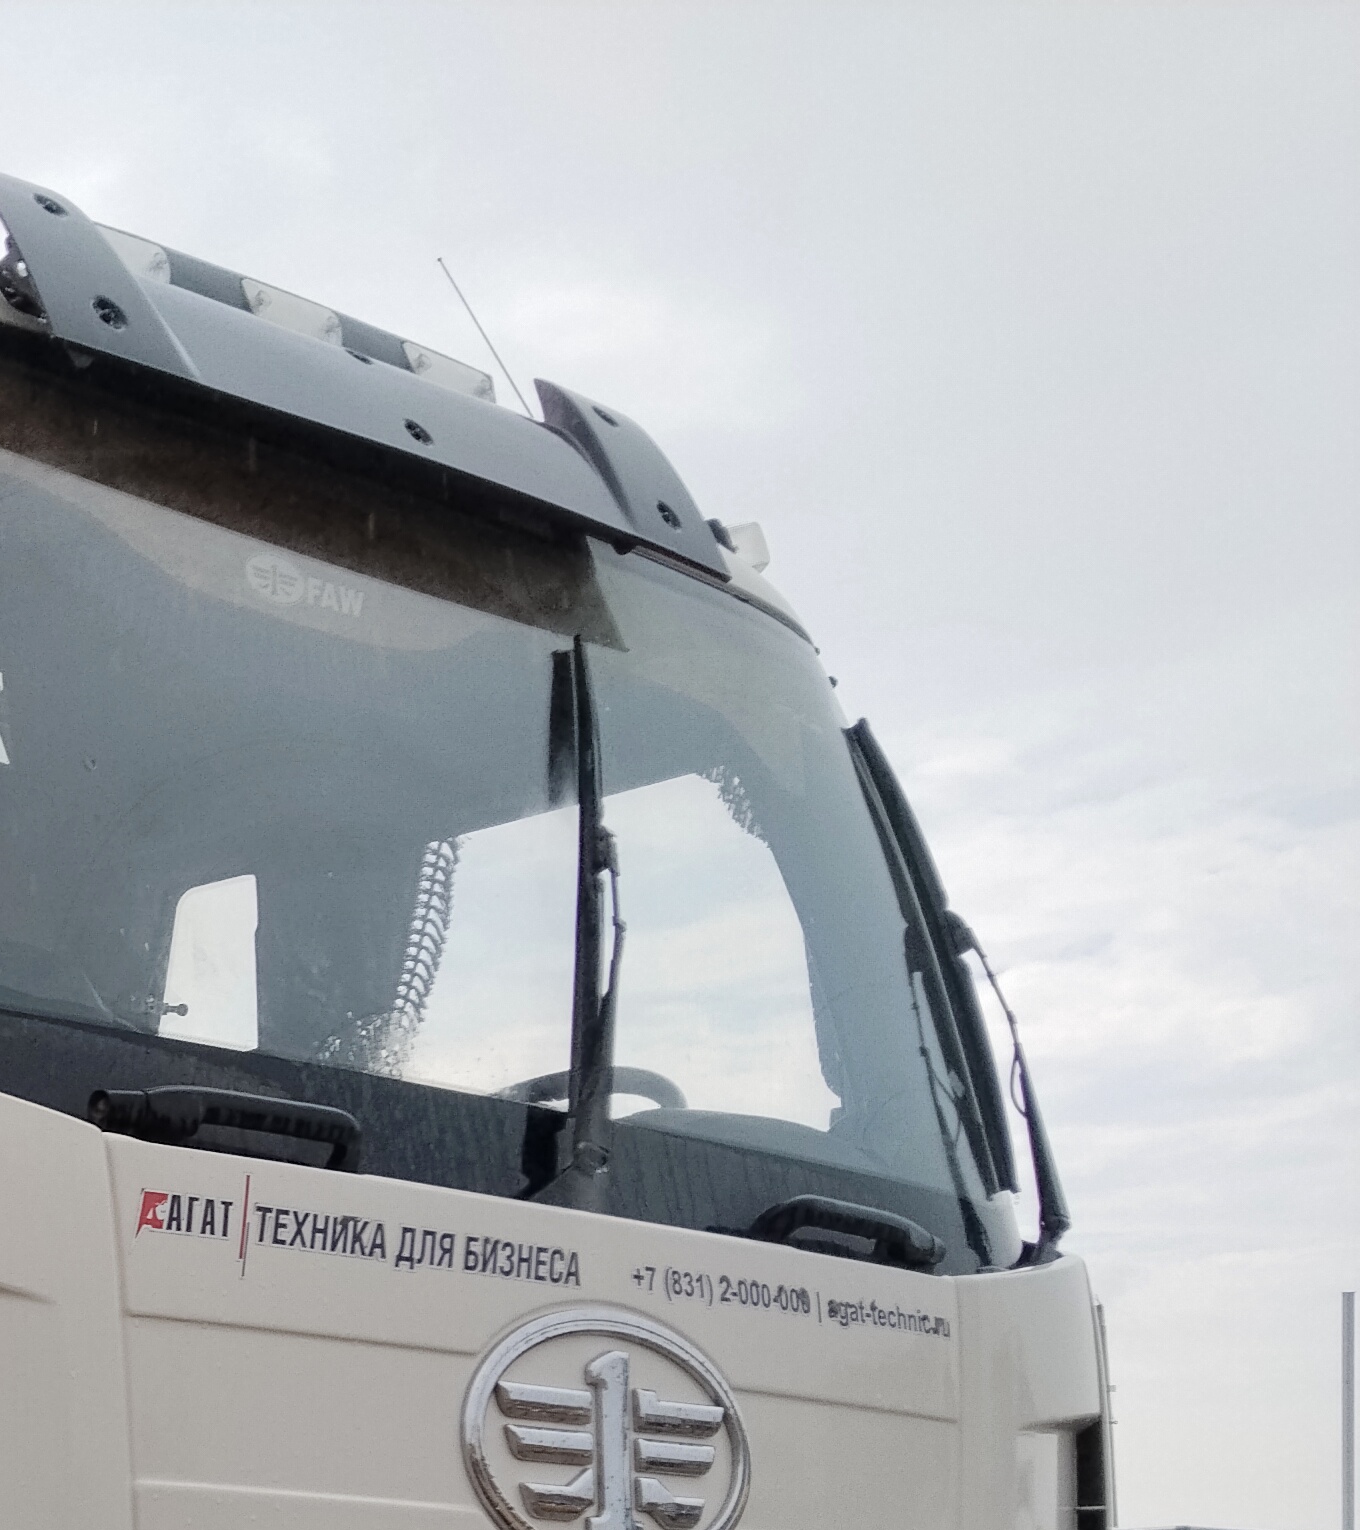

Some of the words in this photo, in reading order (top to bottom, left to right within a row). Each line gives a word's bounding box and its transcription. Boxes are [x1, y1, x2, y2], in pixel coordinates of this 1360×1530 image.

[307, 576, 365, 618] FAW
[255, 1205, 387, 1260] ТЕХНИКА
[395, 1225, 456, 1271] ДЛЯ
[464, 1235, 581, 1287] БИЗНЕСА
[632, 1266, 657, 1292] +7
[664, 1266, 714, 1308] (831)
